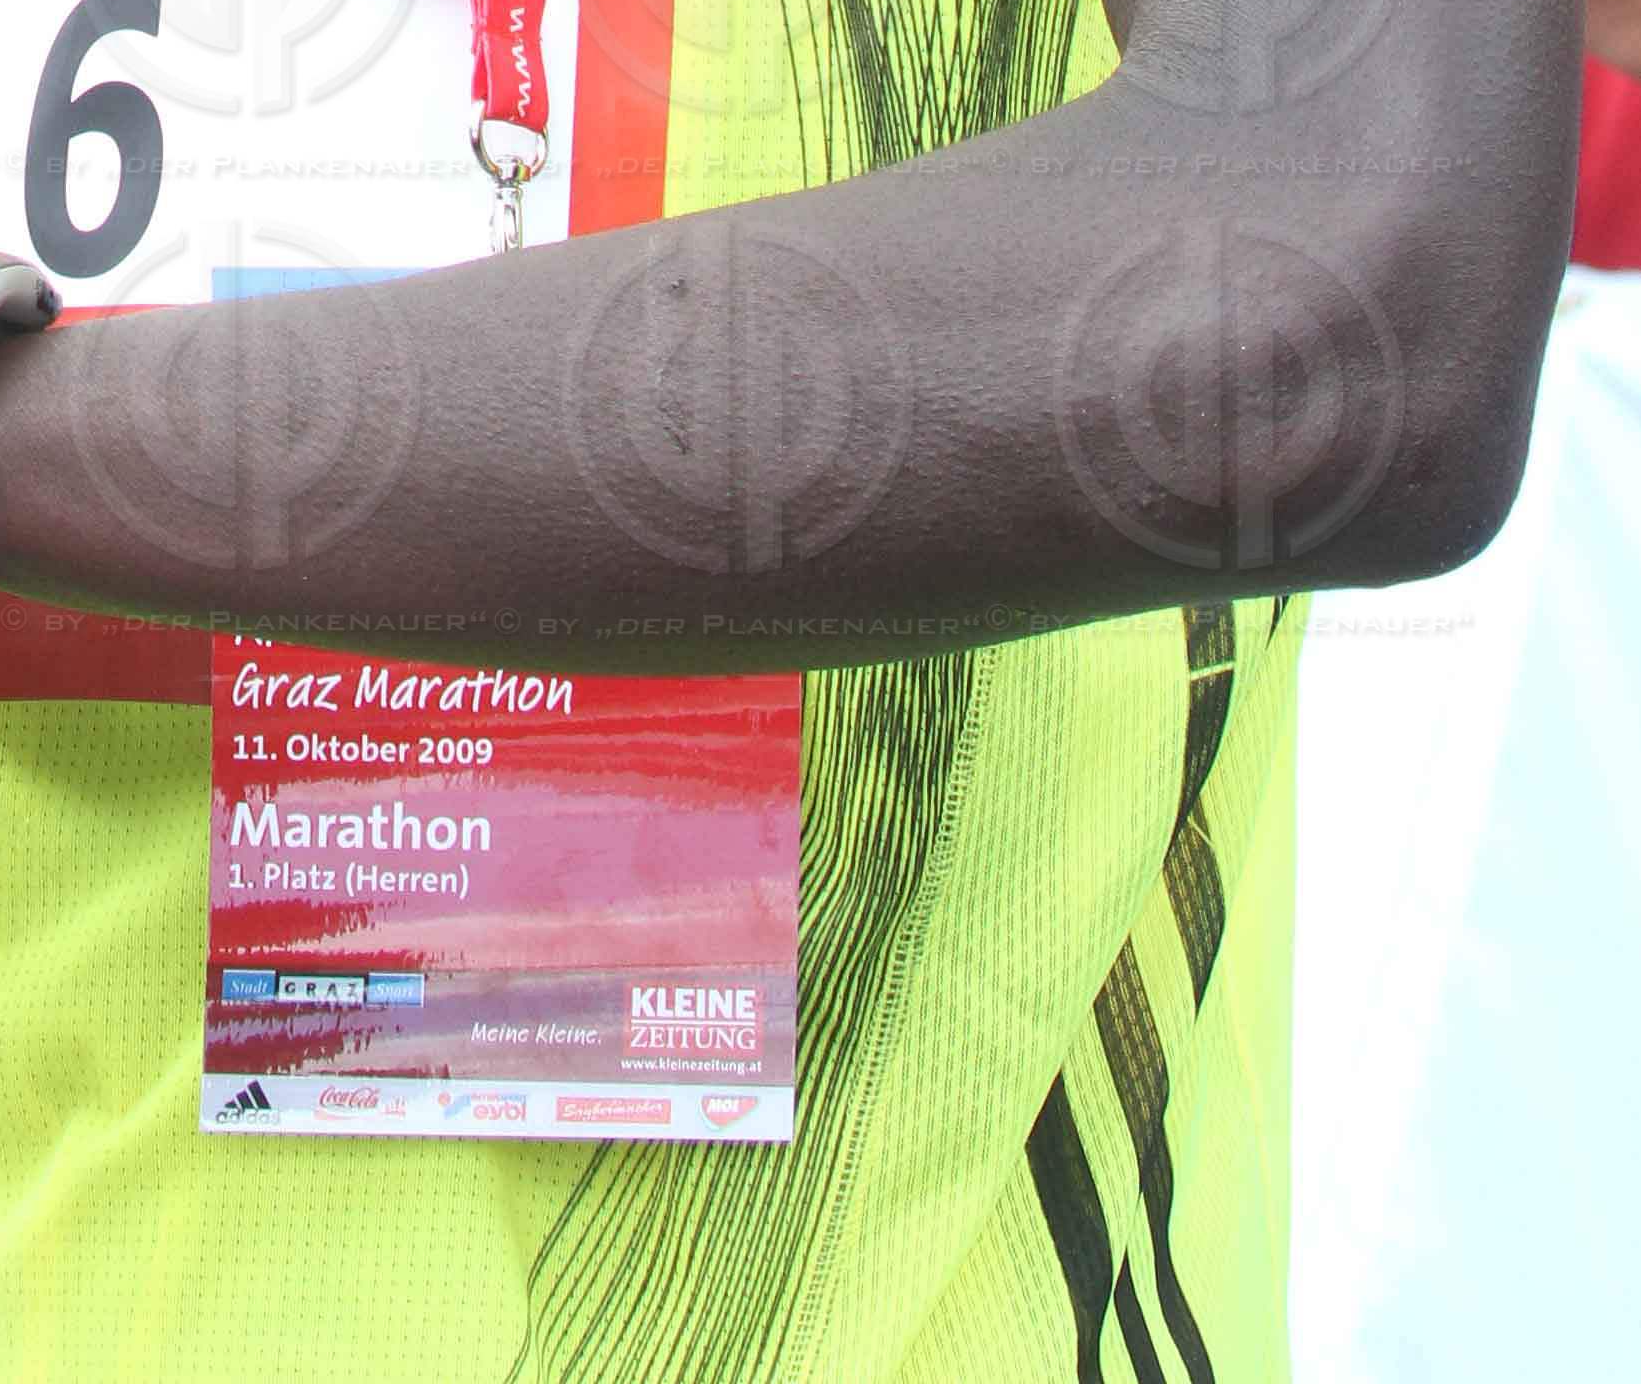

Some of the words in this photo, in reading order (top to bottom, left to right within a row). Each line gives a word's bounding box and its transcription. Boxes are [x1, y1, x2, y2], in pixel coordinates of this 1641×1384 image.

[232, 662, 341, 711] Graz
[354, 664, 574, 714] Marathon
[233, 735, 277, 761] 11.
[286, 733, 409, 763] Oktober
[417, 737, 493, 764] 2009
[229, 801, 491, 851] Marathon
[228, 863, 254, 889] 1.
[263, 862, 335, 891] Platz
[345, 863, 469, 898] (Herren)
[284, 981, 359, 999] GRAZ
[632, 987, 756, 1019] KLEINE
[471, 1022, 529, 1043] Meine
[535, 1024, 602, 1045] Kleine.
[630, 1026, 756, 1050] ZEITUNG
[621, 1057, 762, 1075] www.kleinezeitung.at
[216, 1107, 280, 1125] adidas
